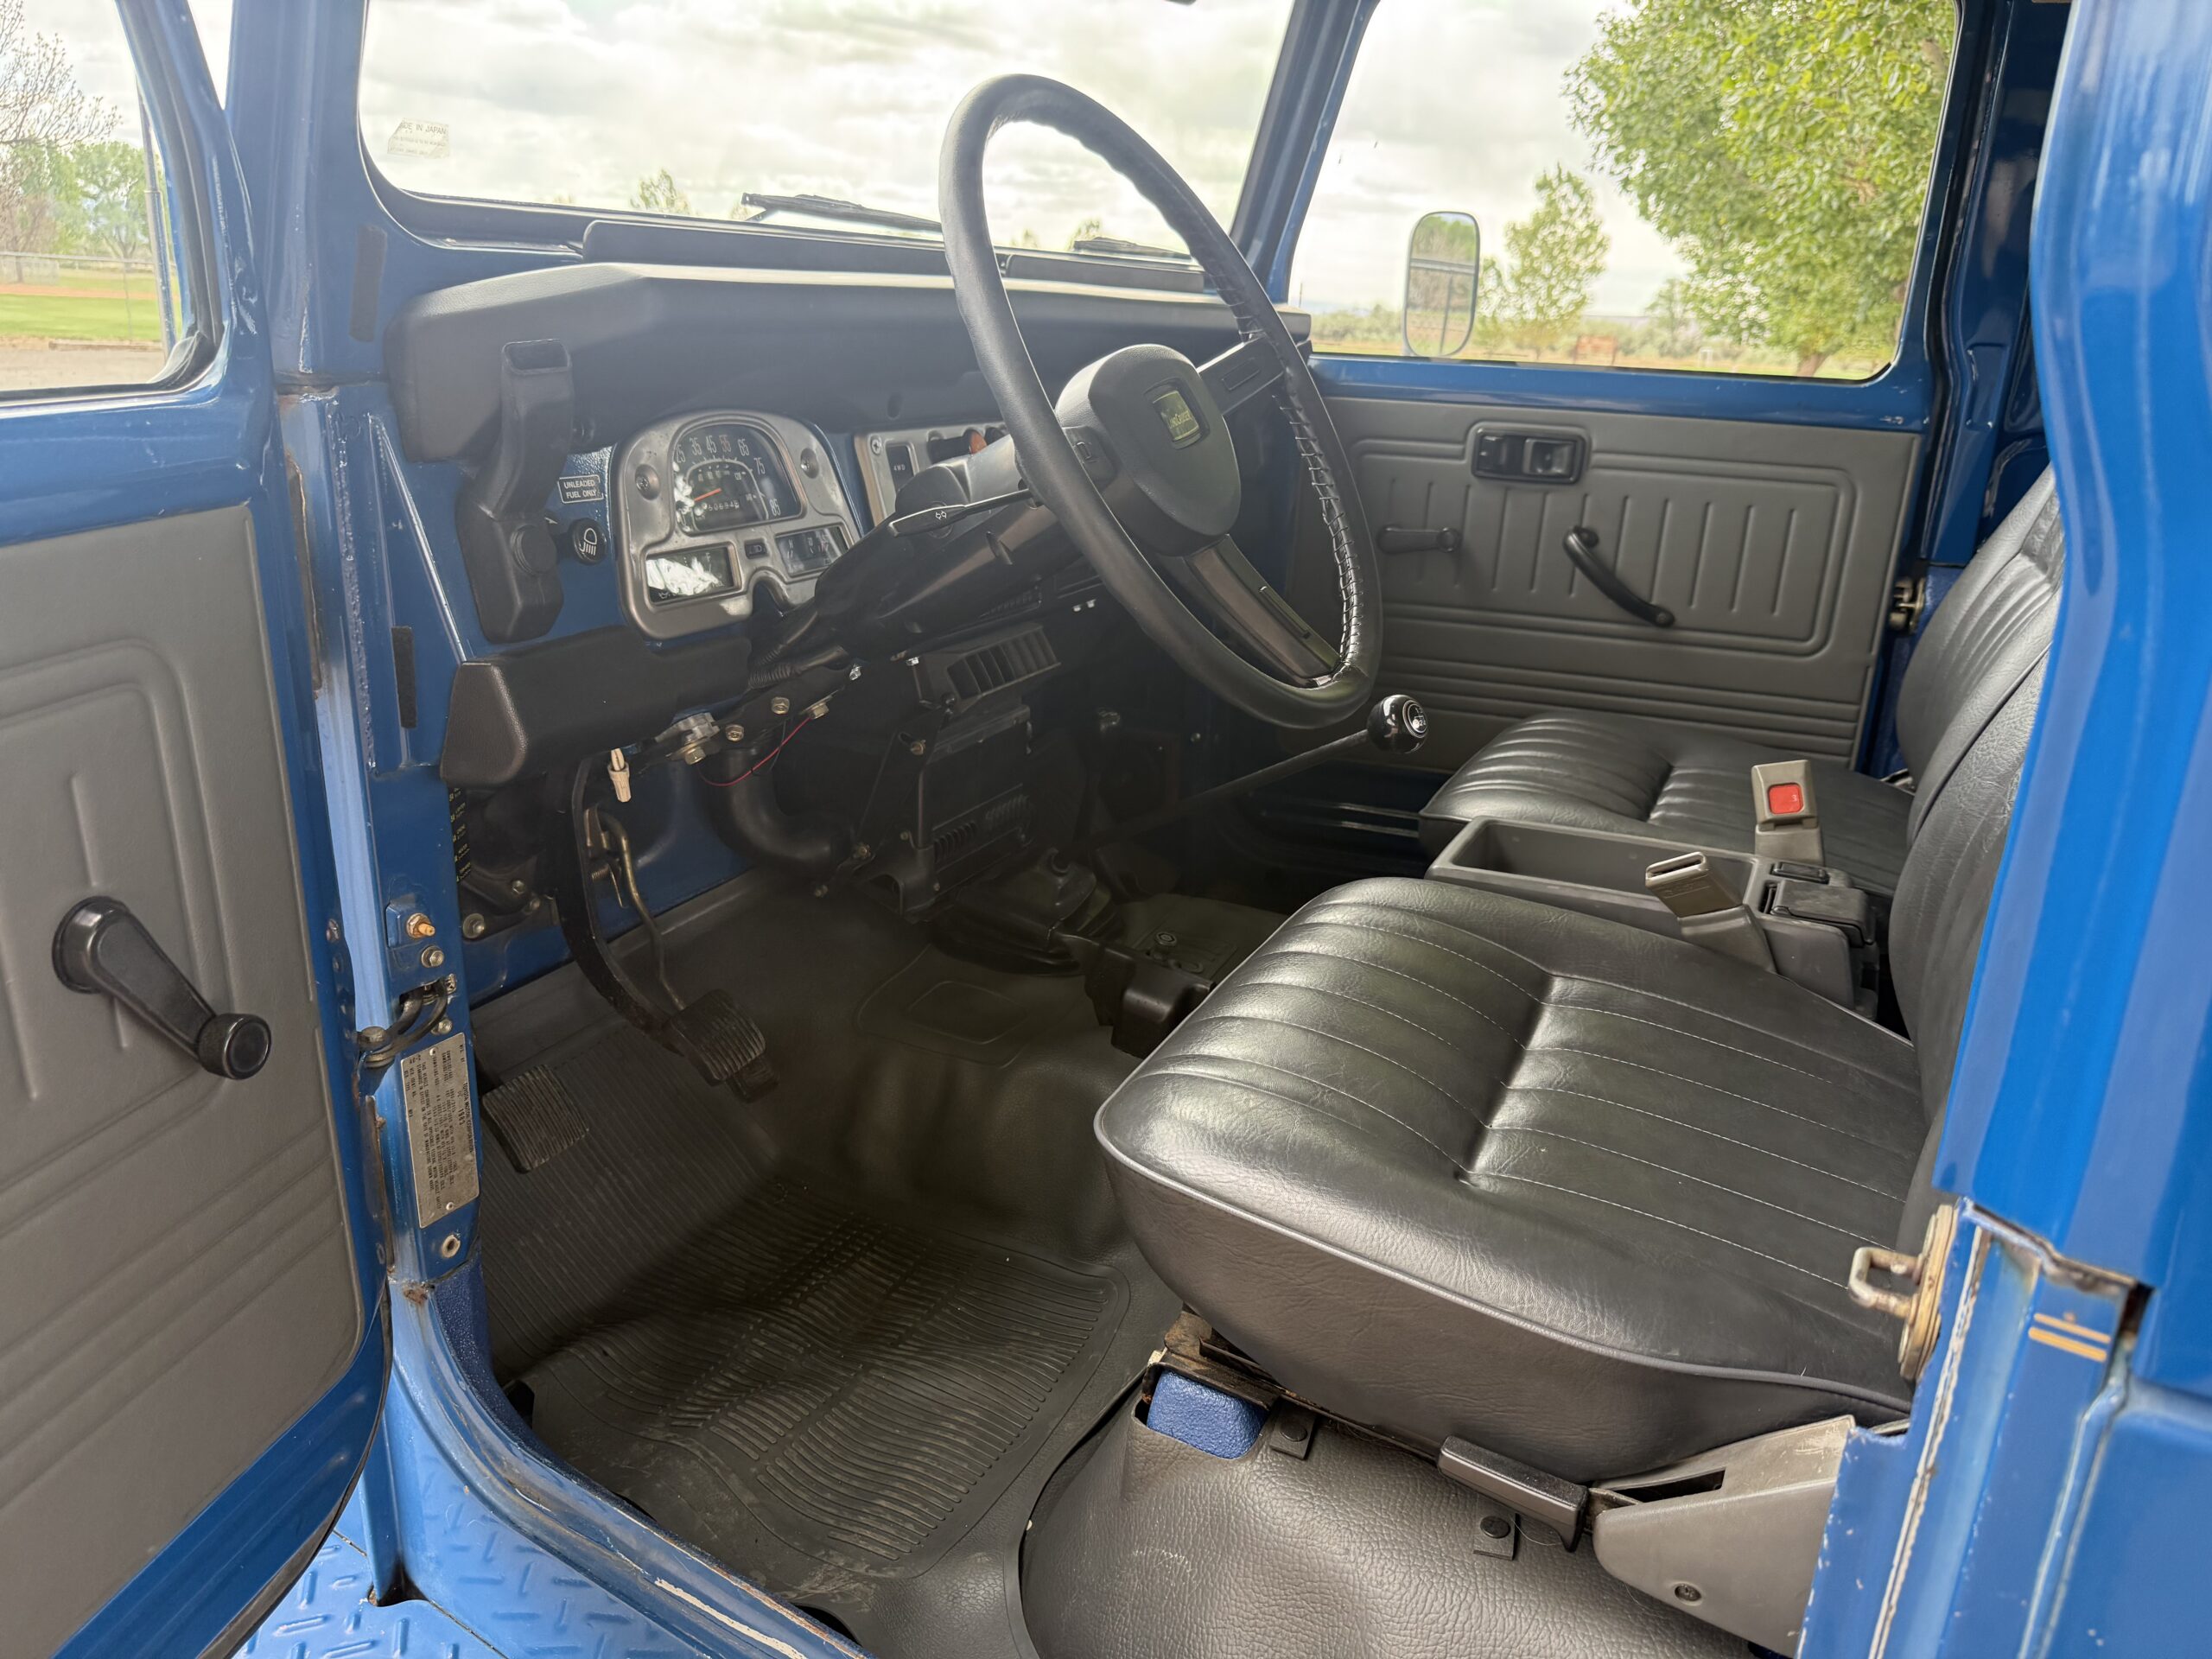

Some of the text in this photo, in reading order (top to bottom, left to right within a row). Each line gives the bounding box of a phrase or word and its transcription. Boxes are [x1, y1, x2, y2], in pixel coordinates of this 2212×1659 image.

[425, 125, 447, 134] JAPAN
[690, 437, 702, 455] 35
[706, 435, 717, 453] 45
[719, 435, 732, 452] 55
[737, 438, 749, 456] 65
[676, 444, 686, 463] 25
[753, 457, 765, 474] 75
[563, 480, 595, 489] UNLEADED
[582, 489, 596, 498] ONLY
[769, 499, 780, 516] 85
